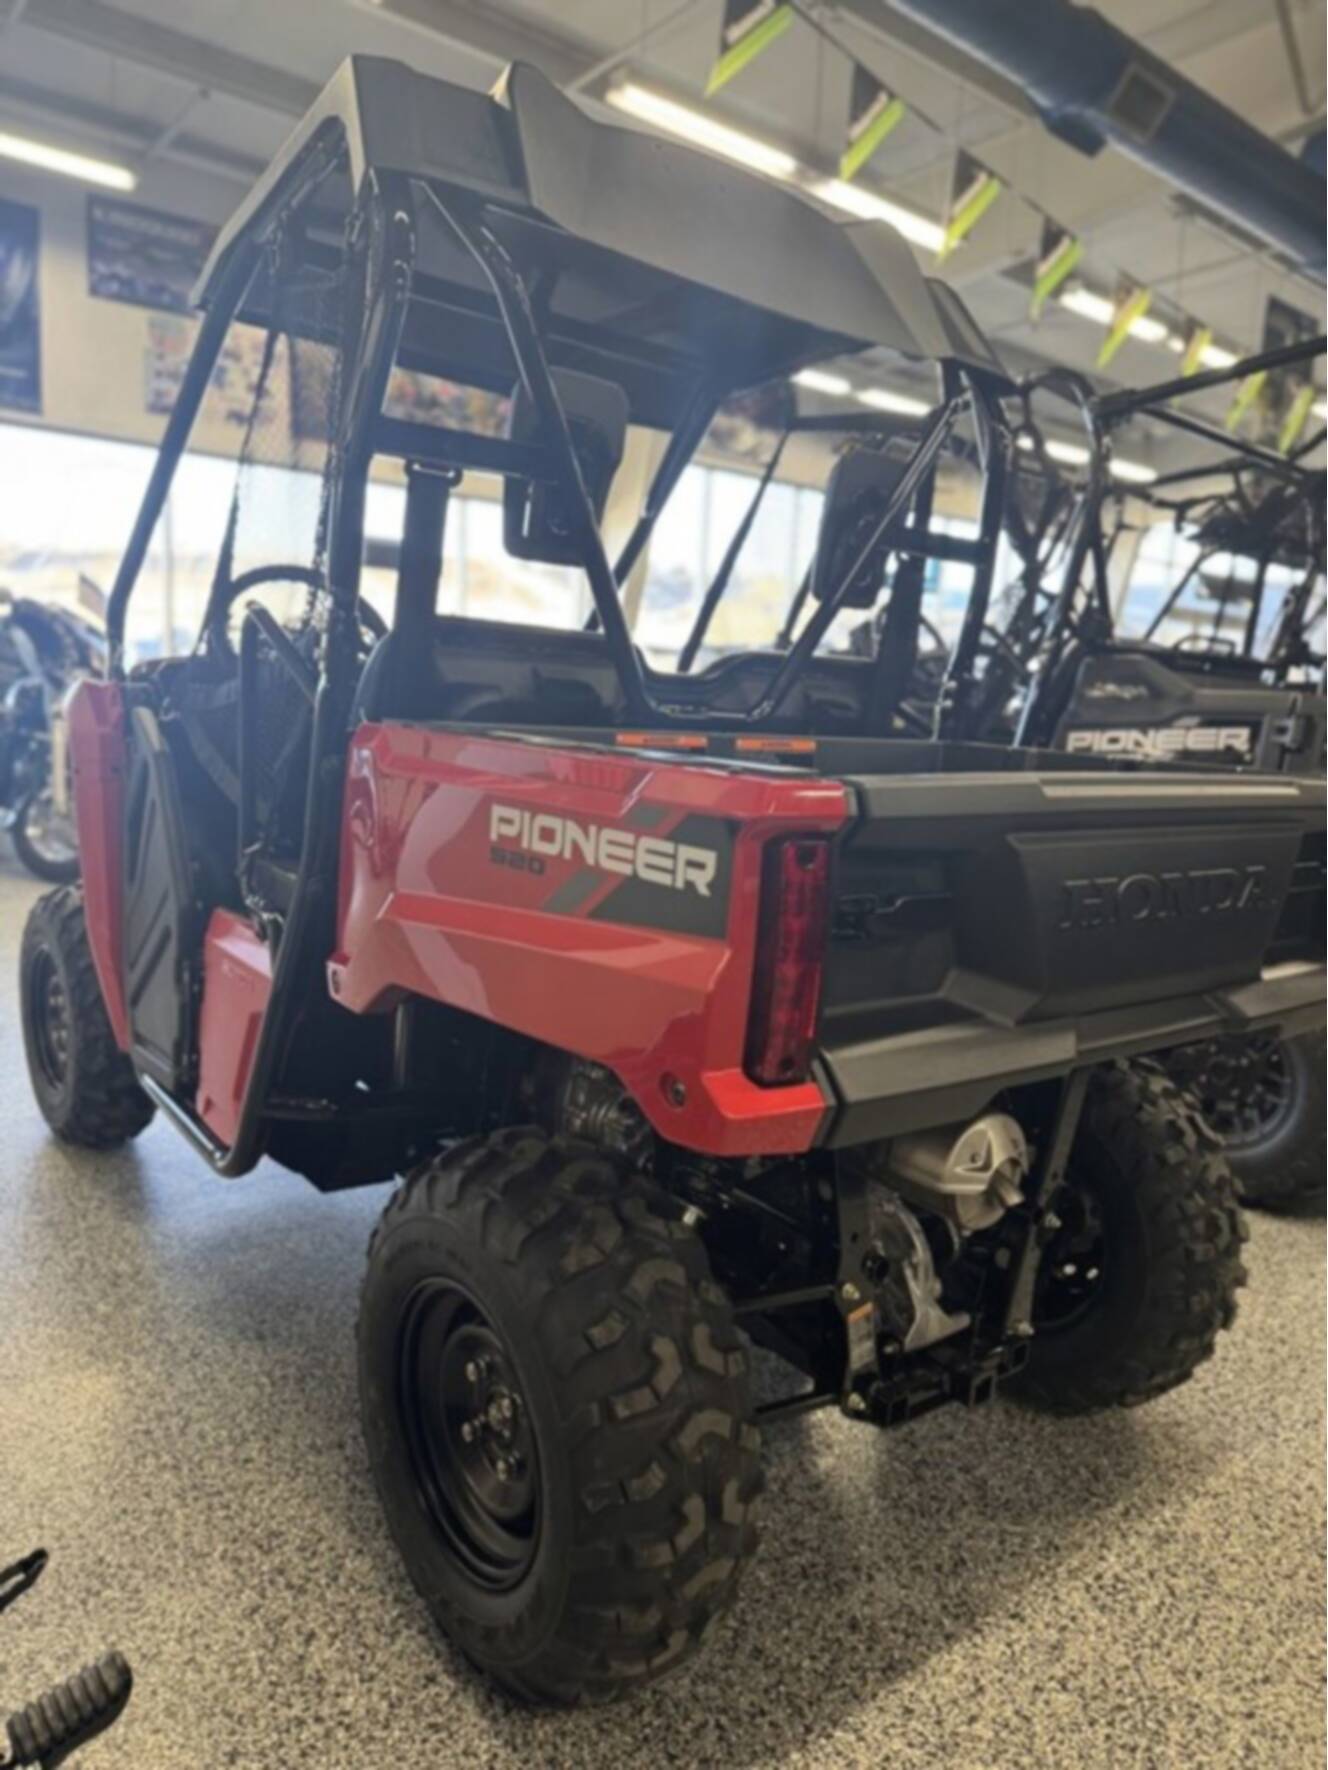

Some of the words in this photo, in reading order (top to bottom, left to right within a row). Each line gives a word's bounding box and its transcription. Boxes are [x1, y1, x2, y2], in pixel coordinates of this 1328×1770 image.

[1066, 727, 1251, 758] PIONEER
[489, 804, 717, 897] PIONEER
[1059, 865, 1277, 928] HONDA
